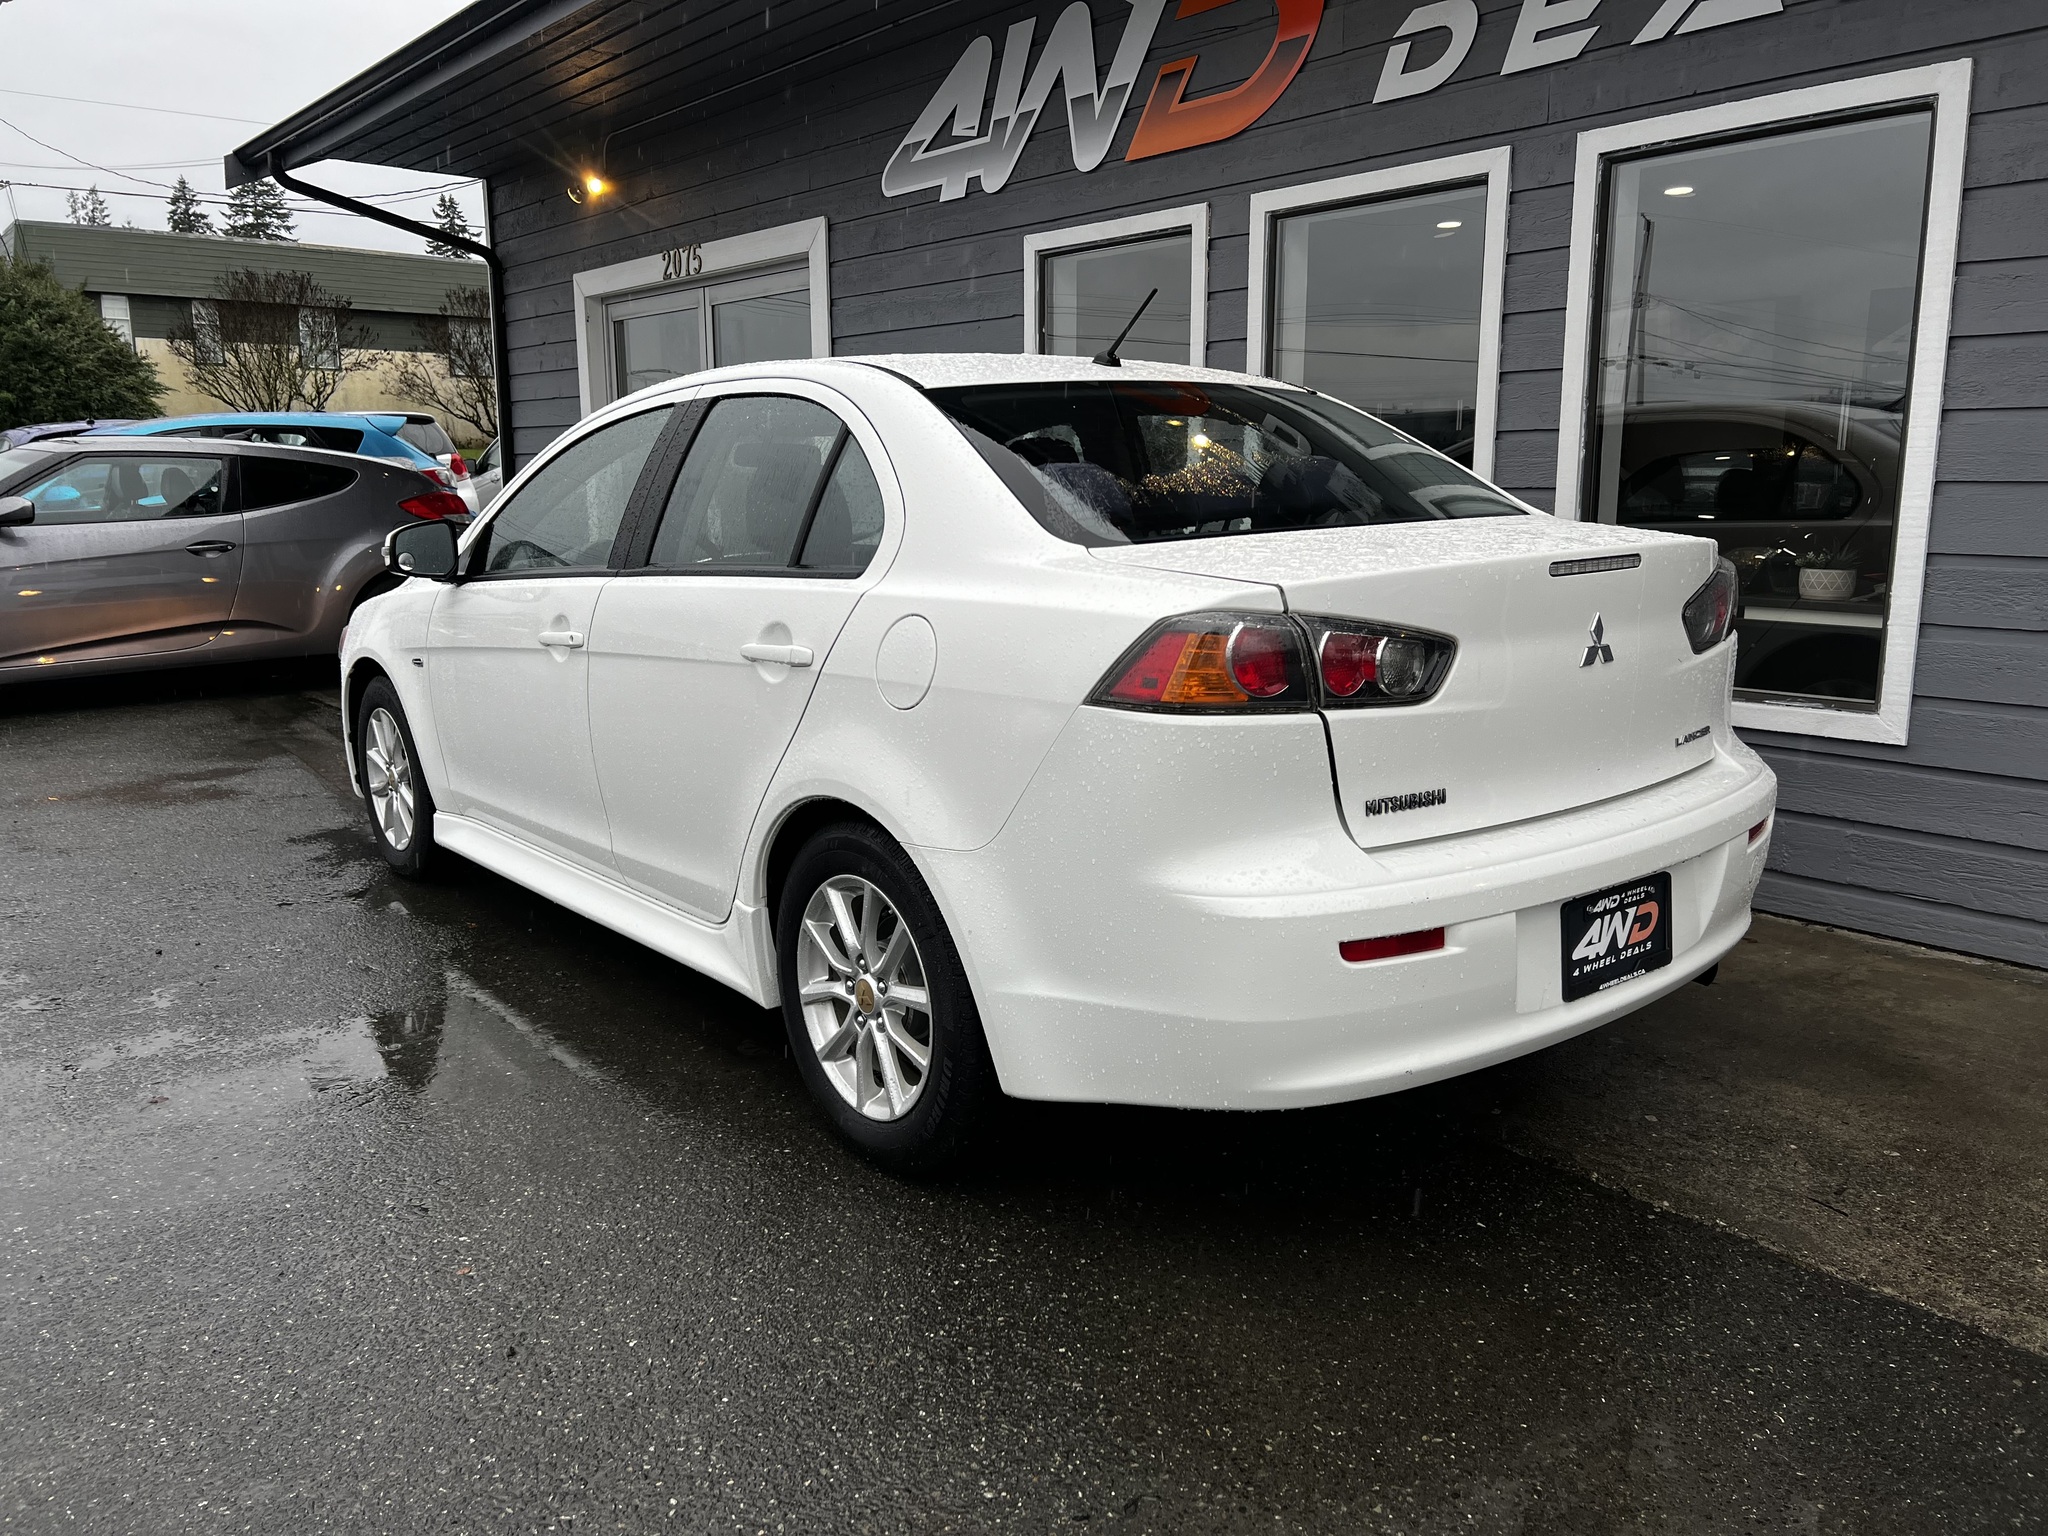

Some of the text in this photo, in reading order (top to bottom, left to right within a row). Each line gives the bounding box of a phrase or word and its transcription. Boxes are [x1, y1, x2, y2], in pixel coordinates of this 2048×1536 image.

[881, 0, 1324, 202] 4WD
[662, 243, 702, 280] 2075
[1674, 725, 1711, 748] LANCER
[1365, 788, 1447, 817] MITSUBISHI
[1623, 892, 1645, 904] DEALS
[1572, 901, 1659, 960] 4WD
[1572, 941, 1652, 976] 4 WHEEL DEALS
